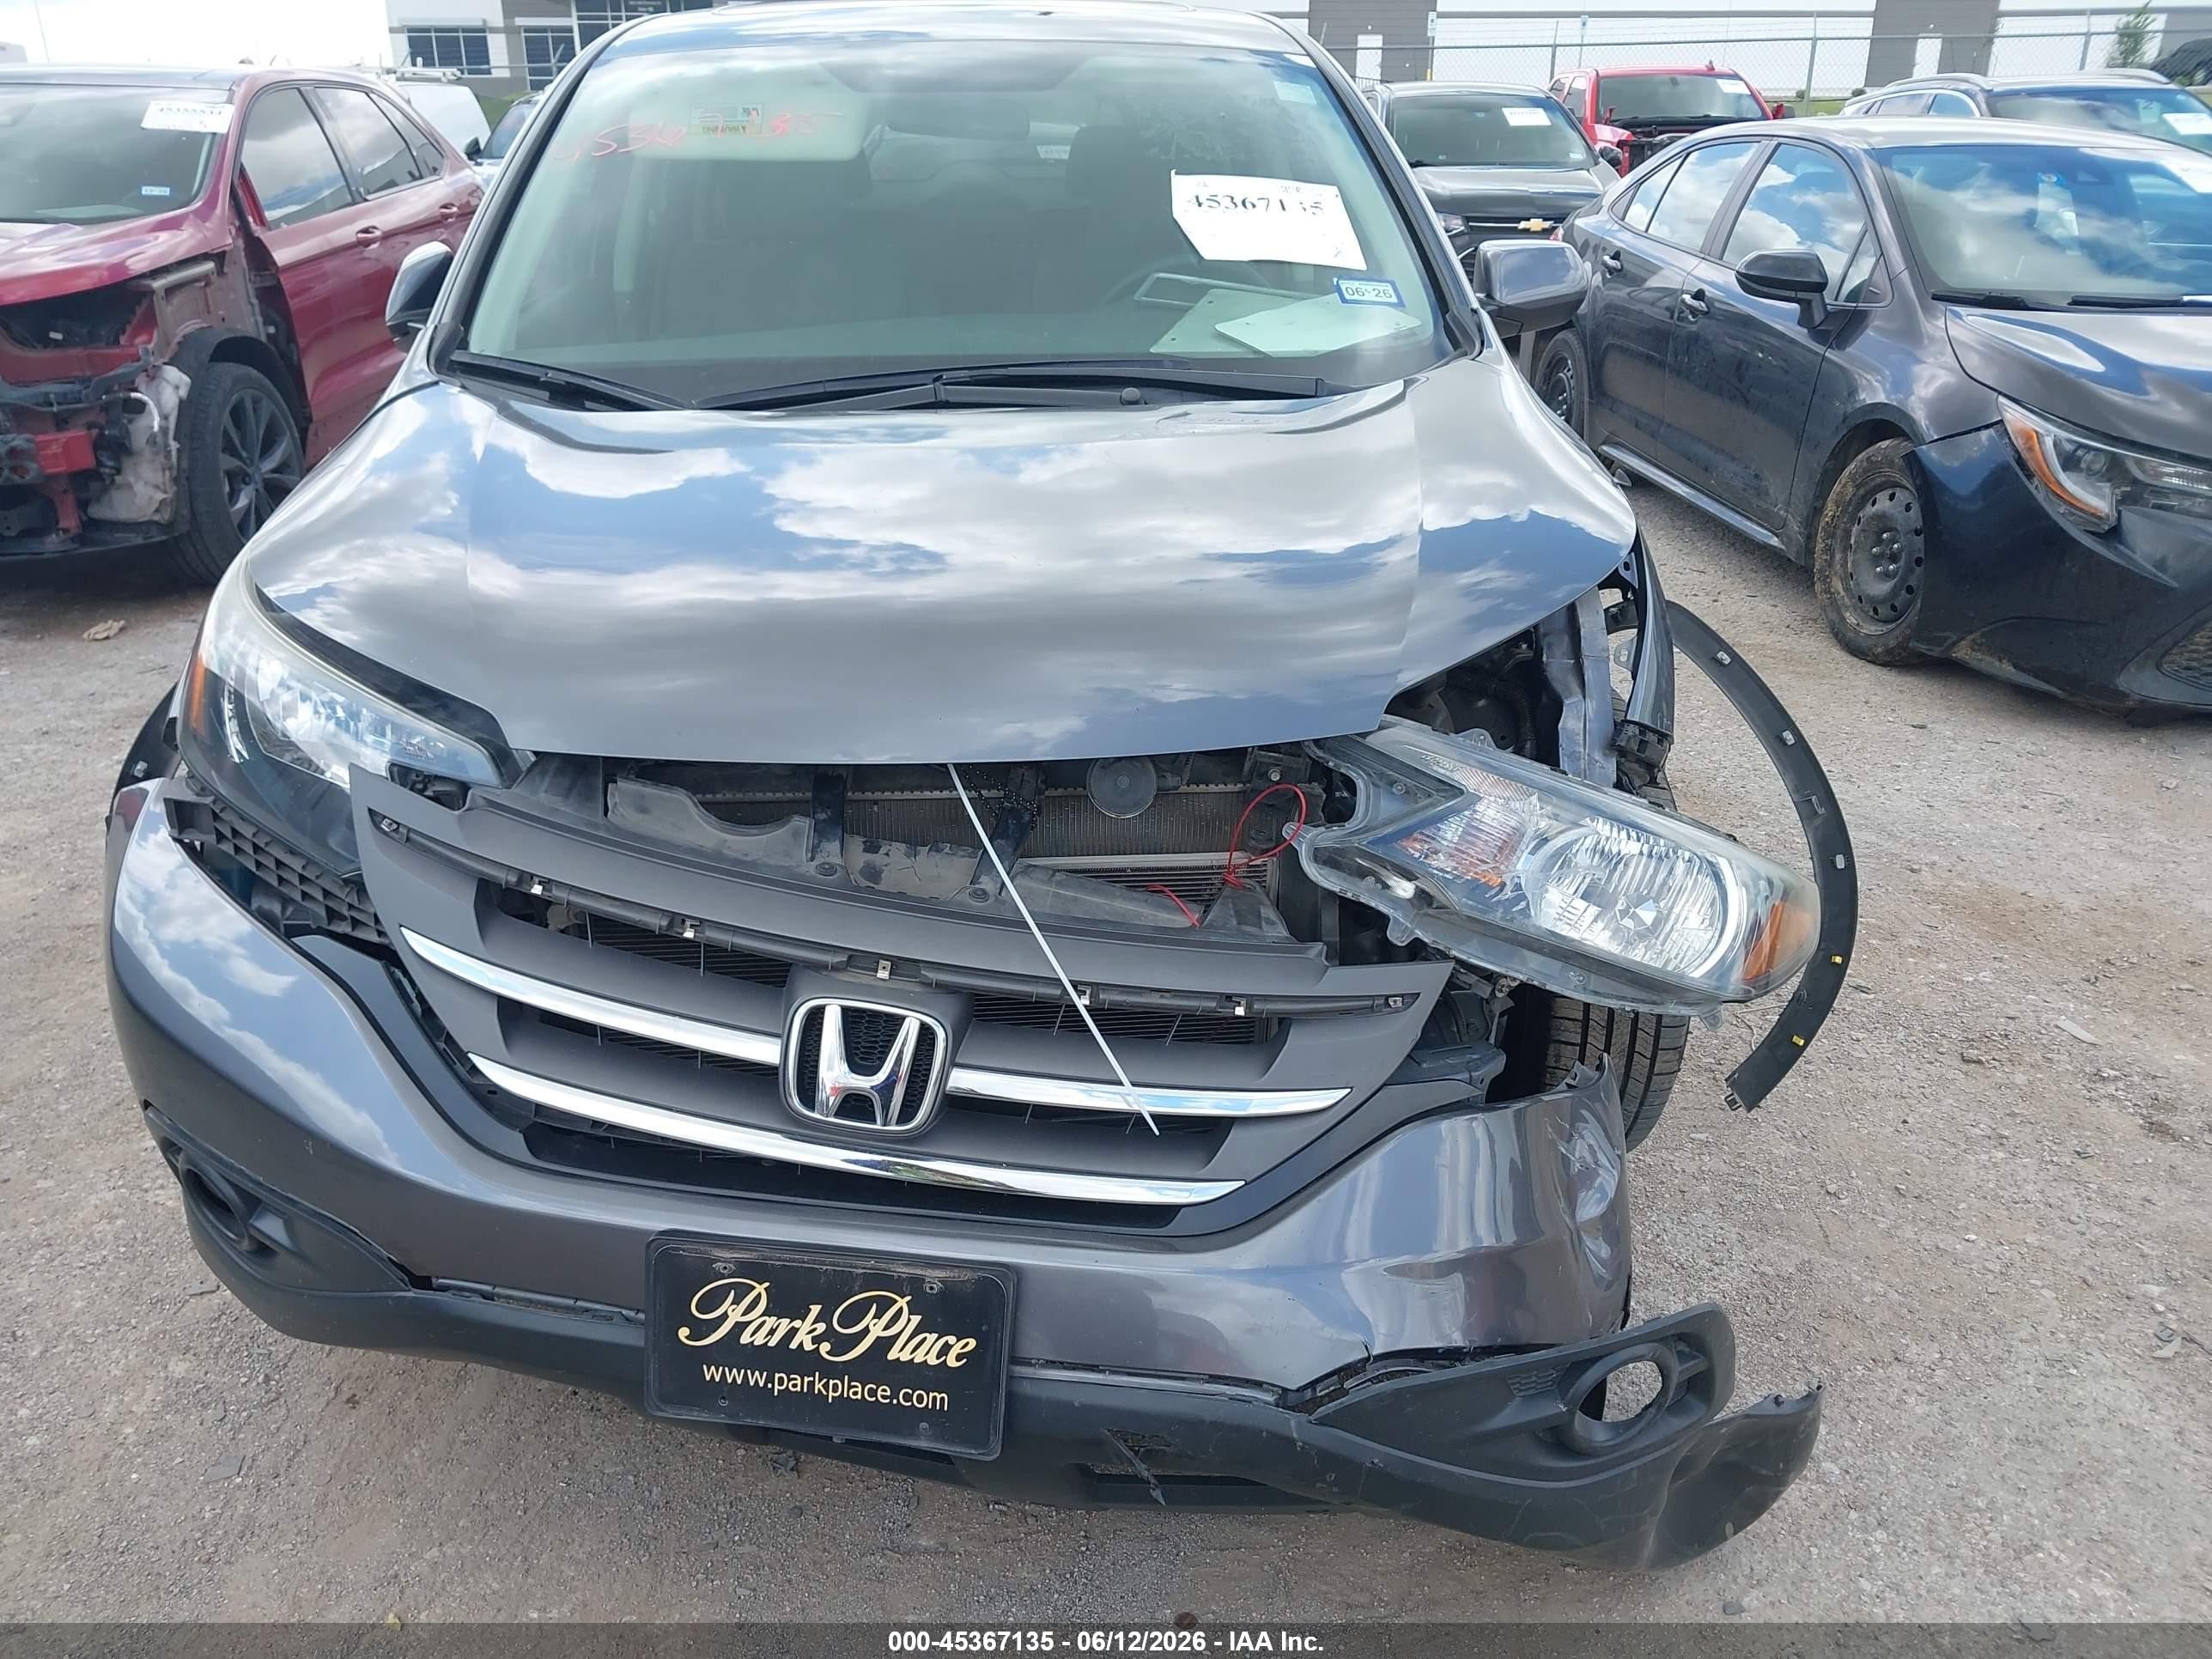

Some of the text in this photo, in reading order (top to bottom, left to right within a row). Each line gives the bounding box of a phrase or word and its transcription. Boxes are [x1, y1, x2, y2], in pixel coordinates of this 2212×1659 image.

[1345, 286, 1393, 299] 06 26
[678, 1278, 977, 1368] Park Place
[702, 1364, 949, 1412] www.parkplace.com
